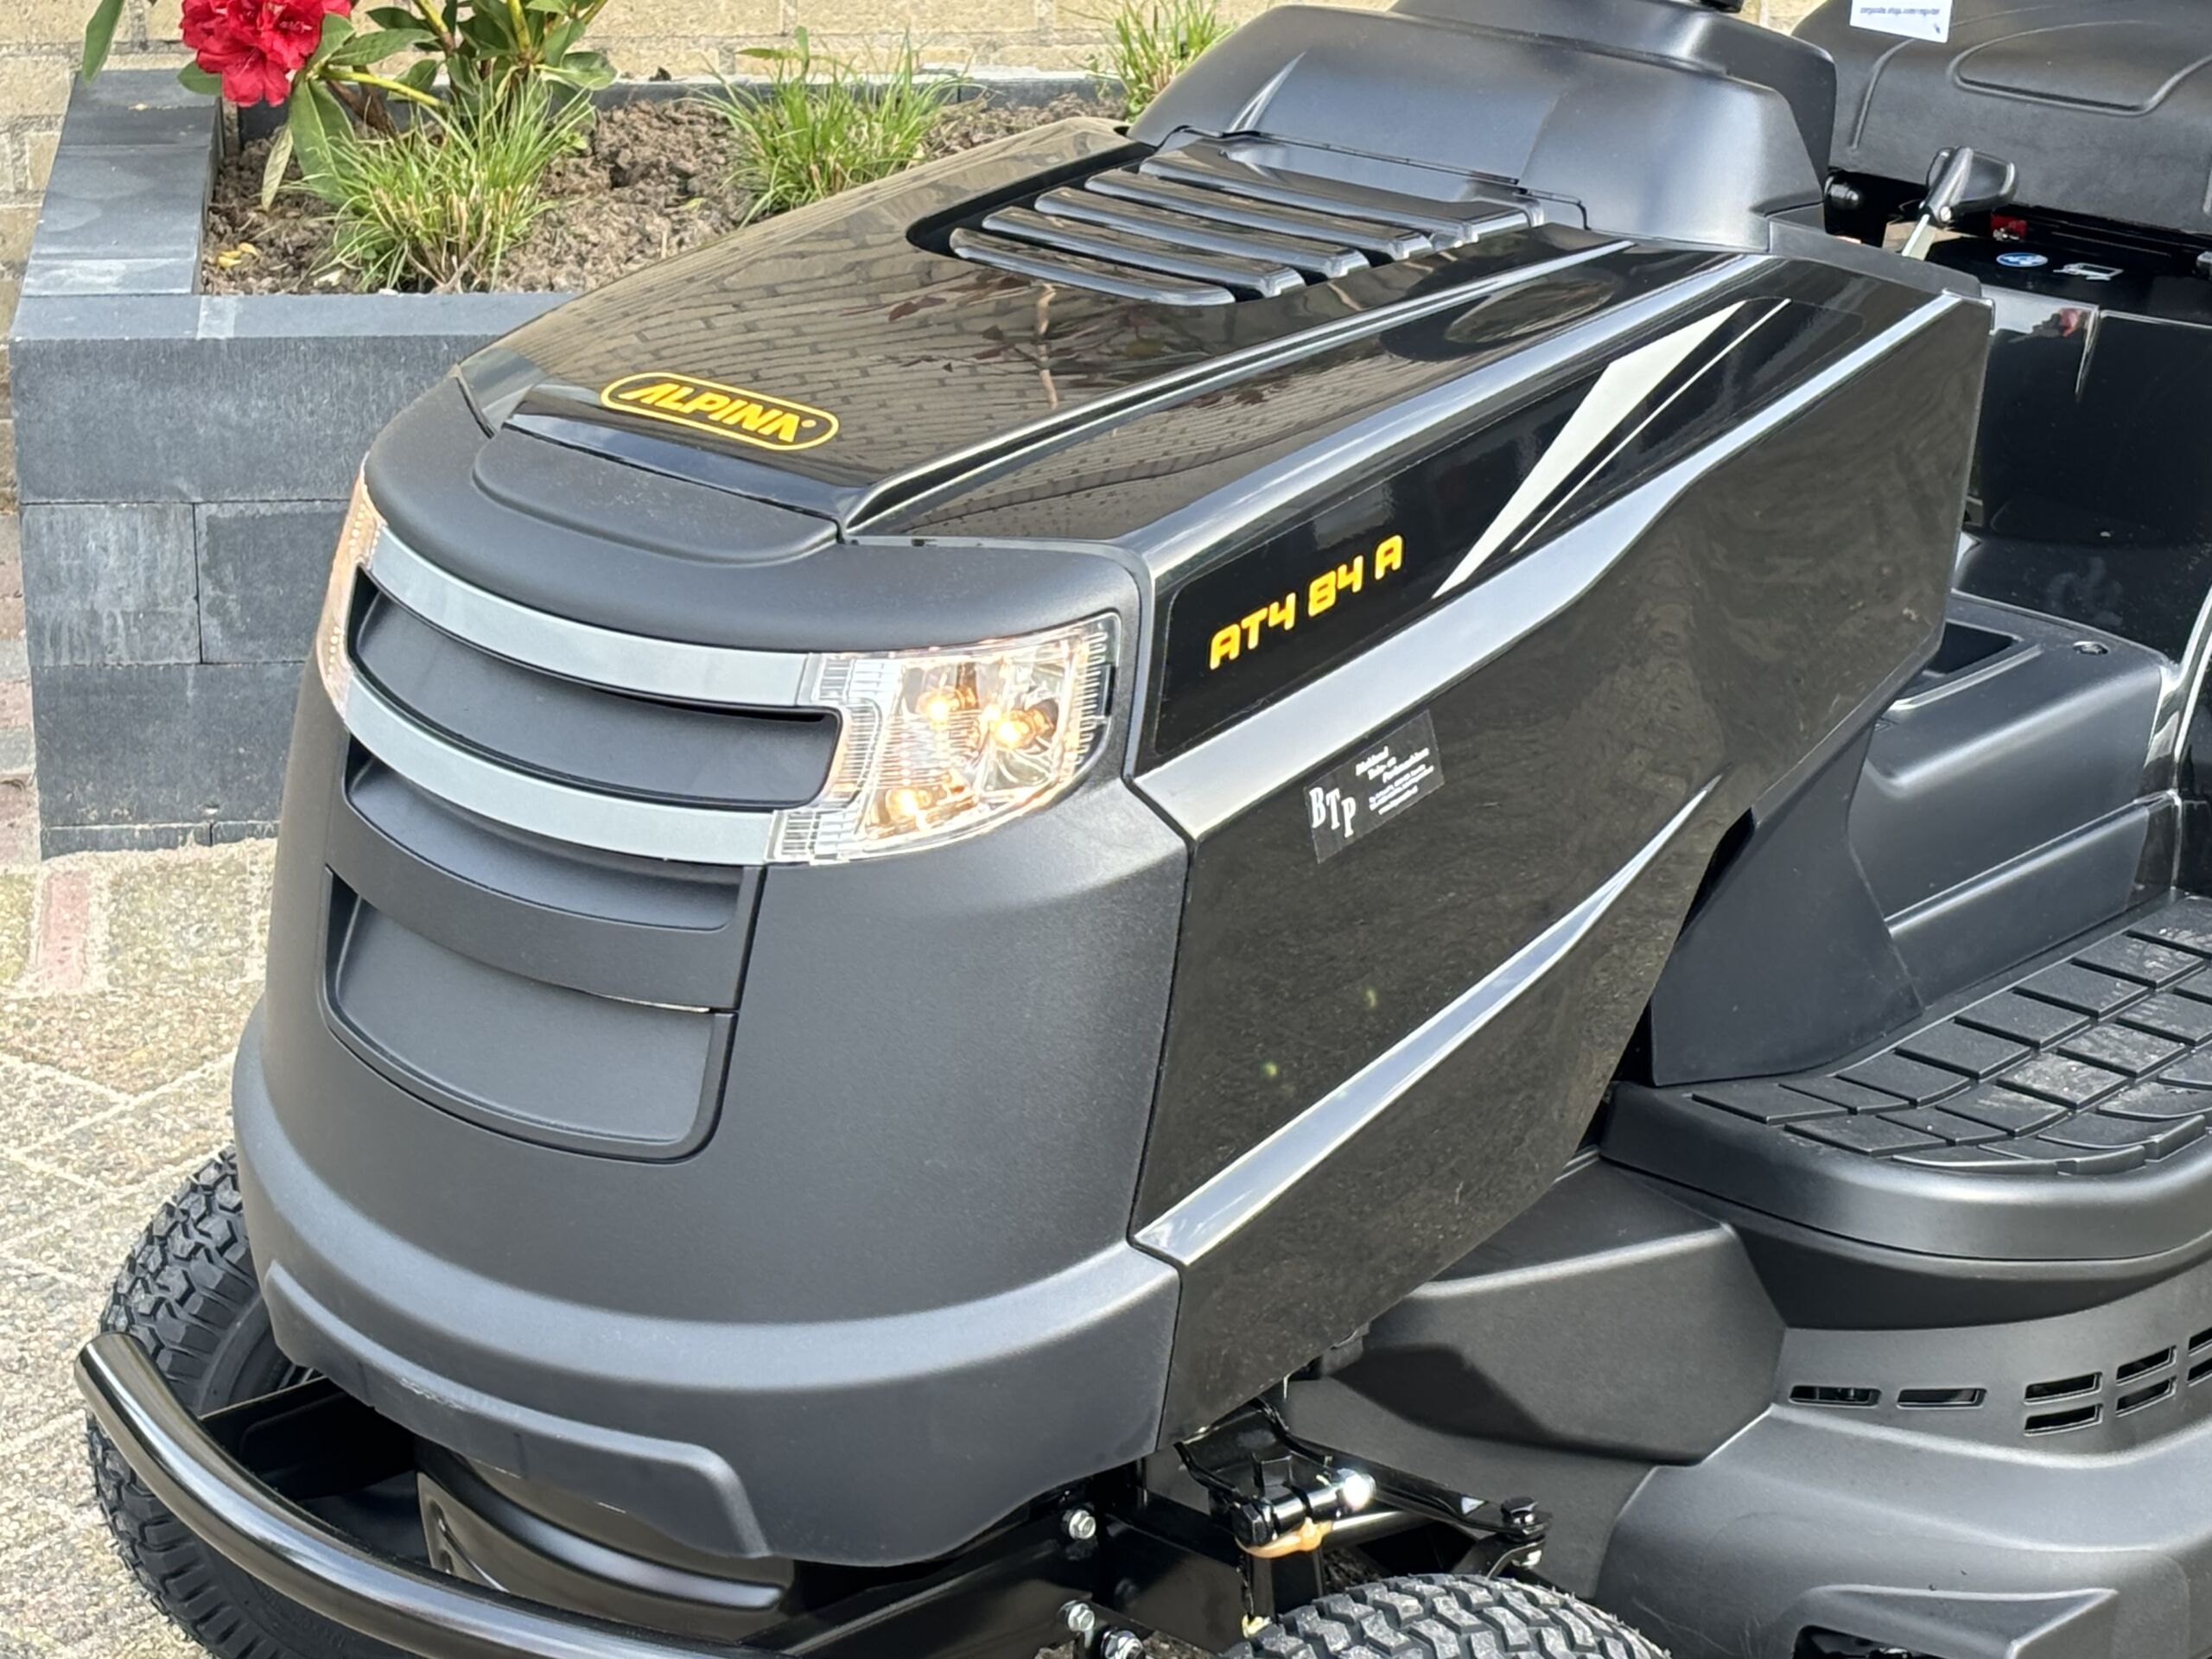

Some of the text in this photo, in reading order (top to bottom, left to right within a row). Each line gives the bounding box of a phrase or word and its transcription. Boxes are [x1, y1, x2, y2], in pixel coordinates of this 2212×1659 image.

[619, 383, 800, 442] ALPINA
[1210, 534, 1403, 671] AT4 84 A
